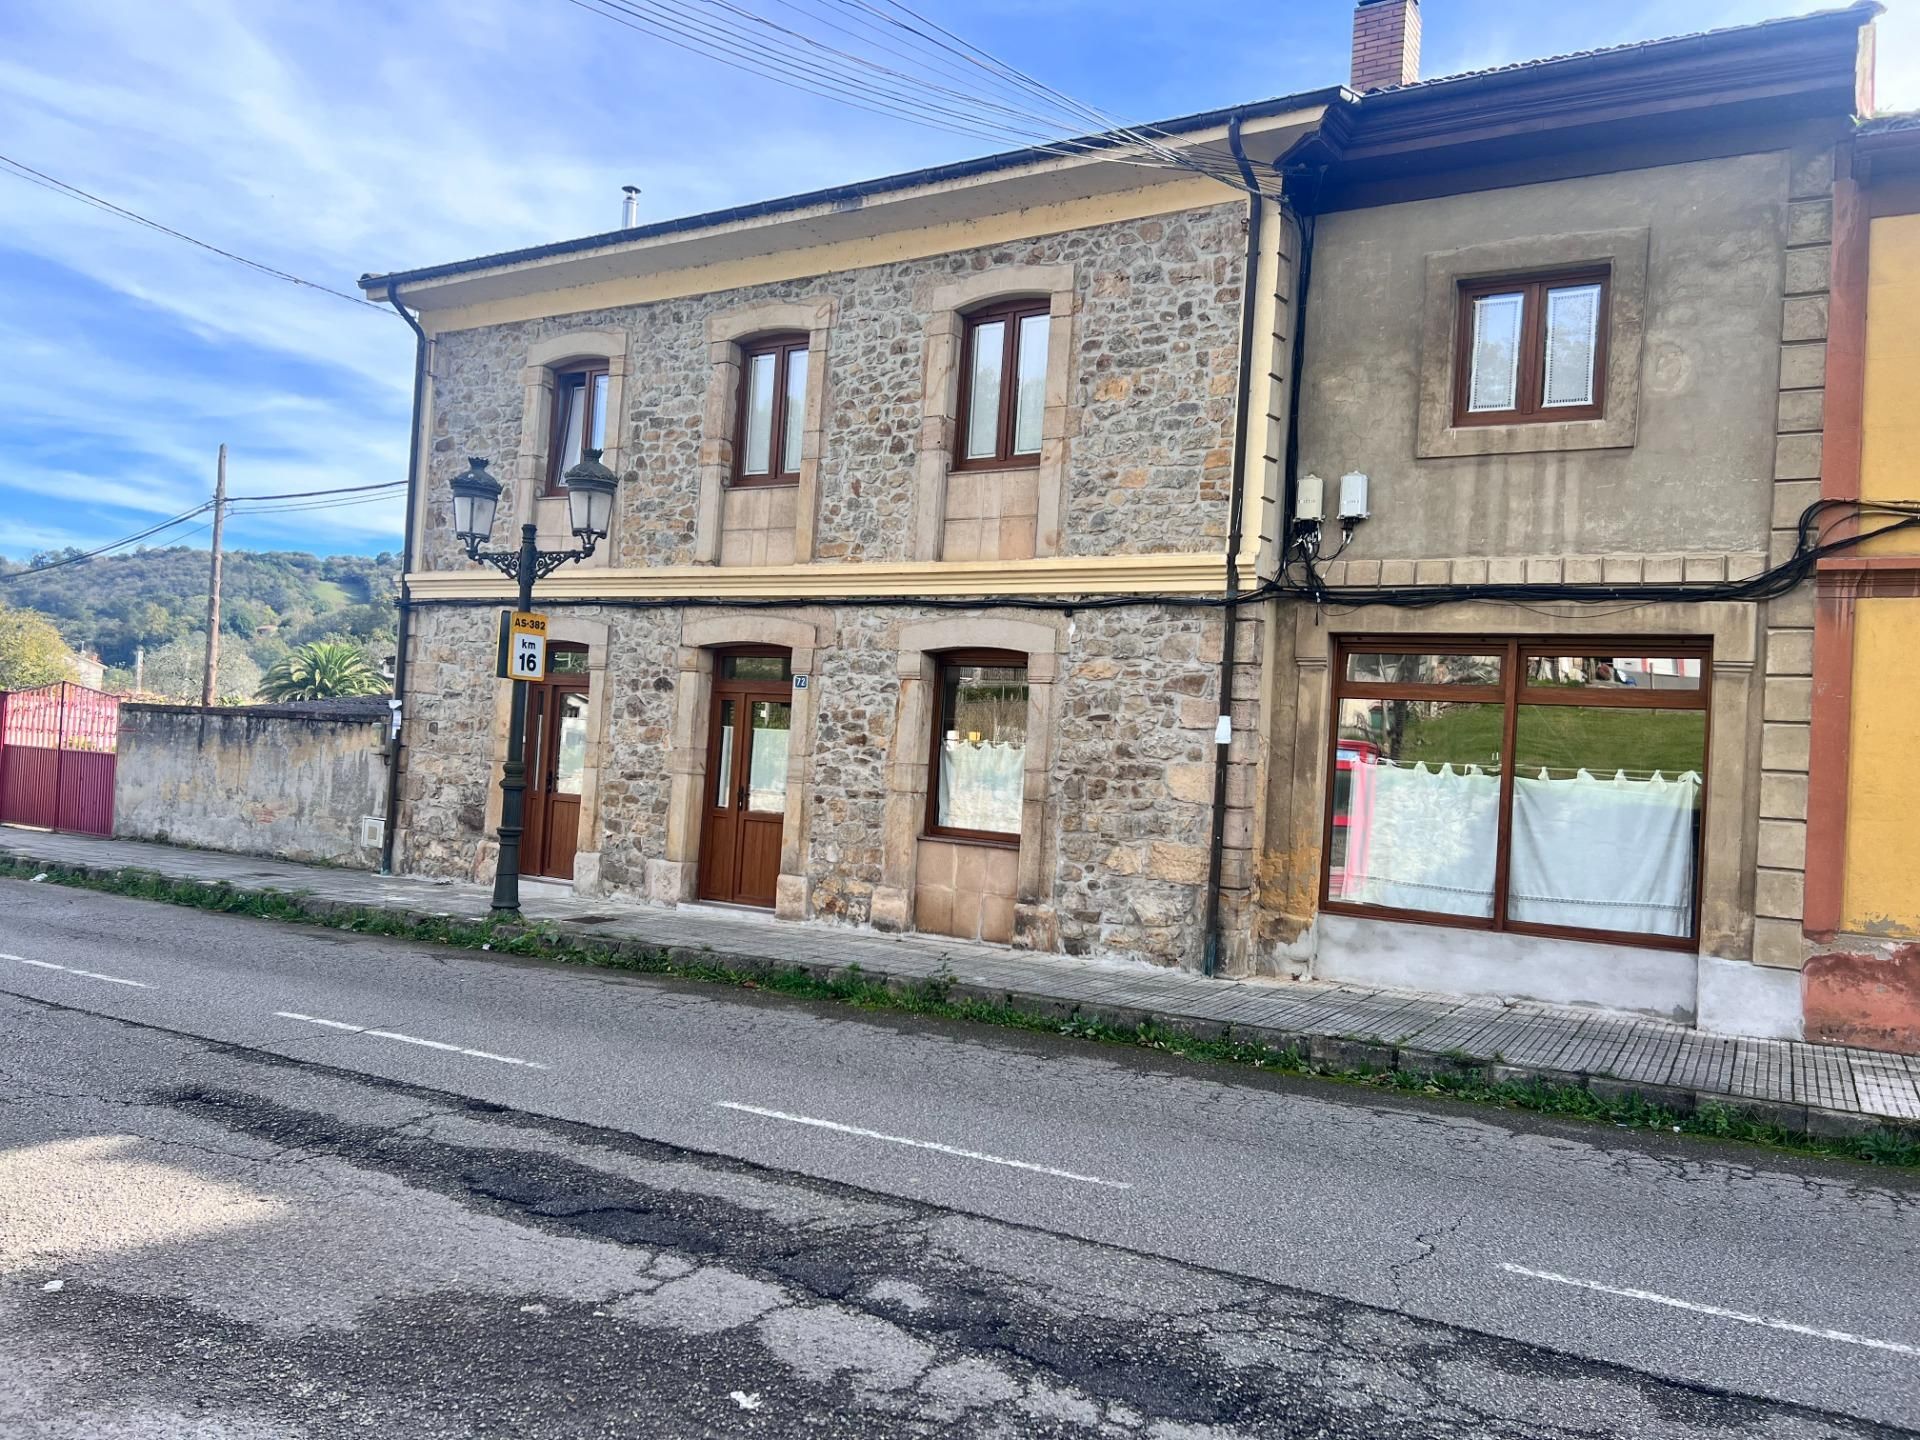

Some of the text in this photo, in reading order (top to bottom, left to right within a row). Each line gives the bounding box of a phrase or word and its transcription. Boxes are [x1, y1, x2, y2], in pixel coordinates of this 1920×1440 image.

[515, 618, 546, 630] AS-382
[522, 639, 536, 649] km
[519, 653, 537, 671] 16
[796, 677, 806, 686] 72
